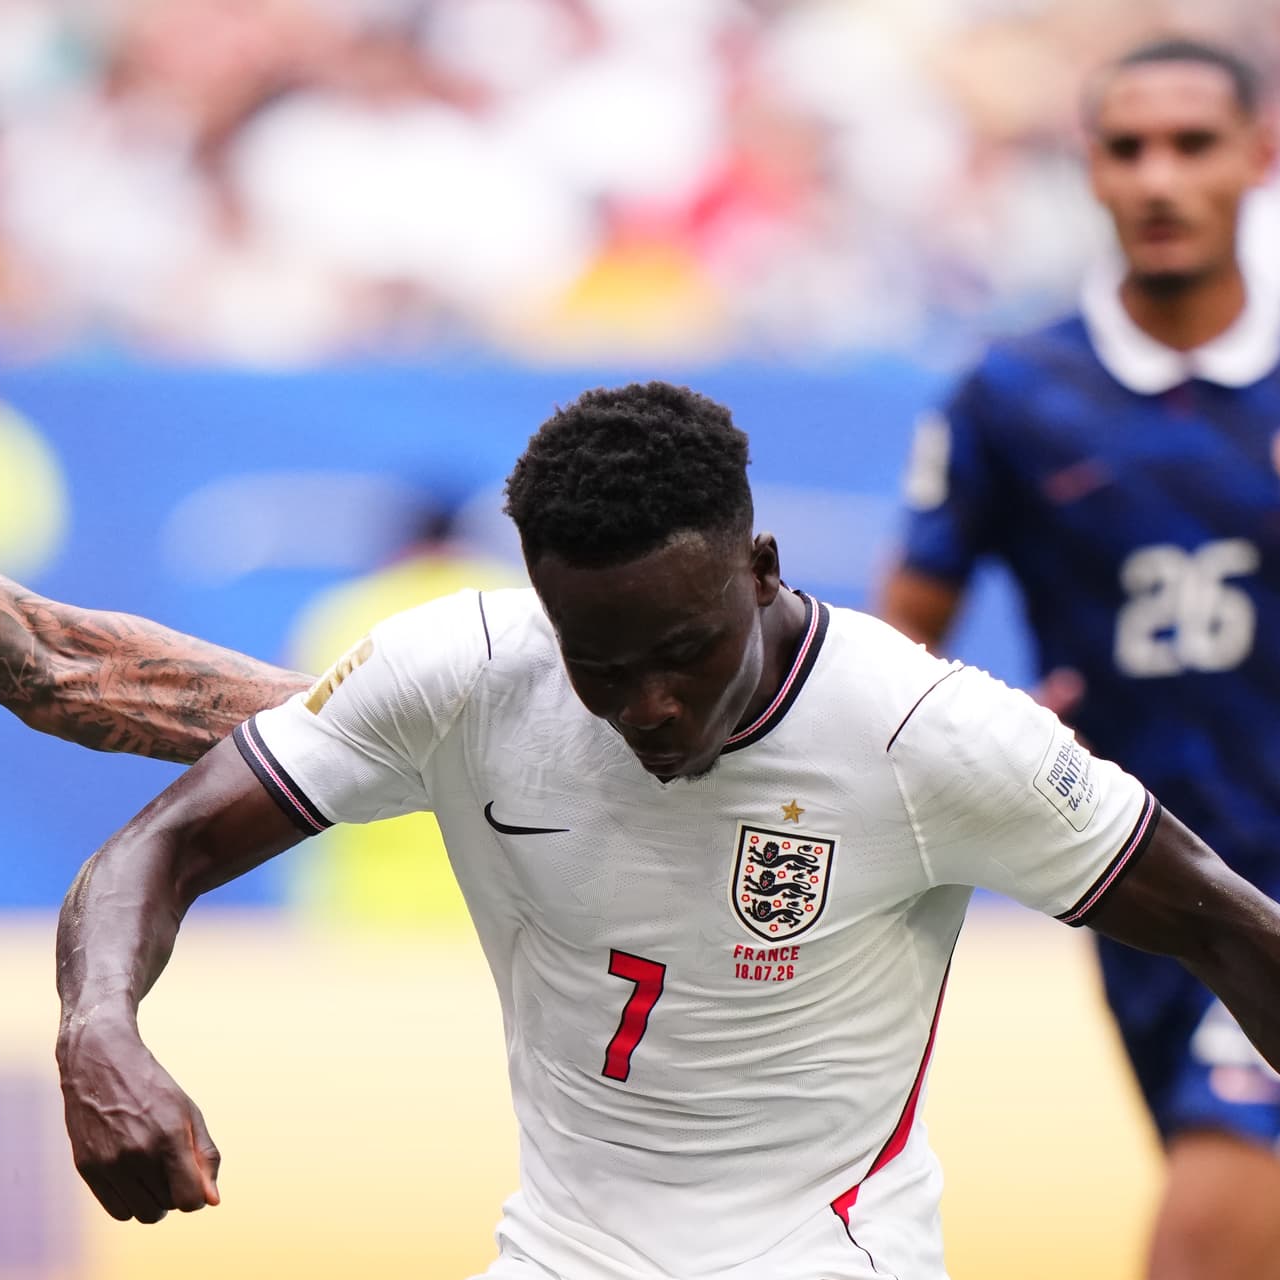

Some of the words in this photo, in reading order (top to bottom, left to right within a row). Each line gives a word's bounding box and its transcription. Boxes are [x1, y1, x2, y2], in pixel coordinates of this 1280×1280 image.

[1113, 538, 1261, 679] 26
[733, 944, 801, 962] FRANCE
[735, 963, 795, 982] 18.07.26
[601, 948, 667, 1083] 7
